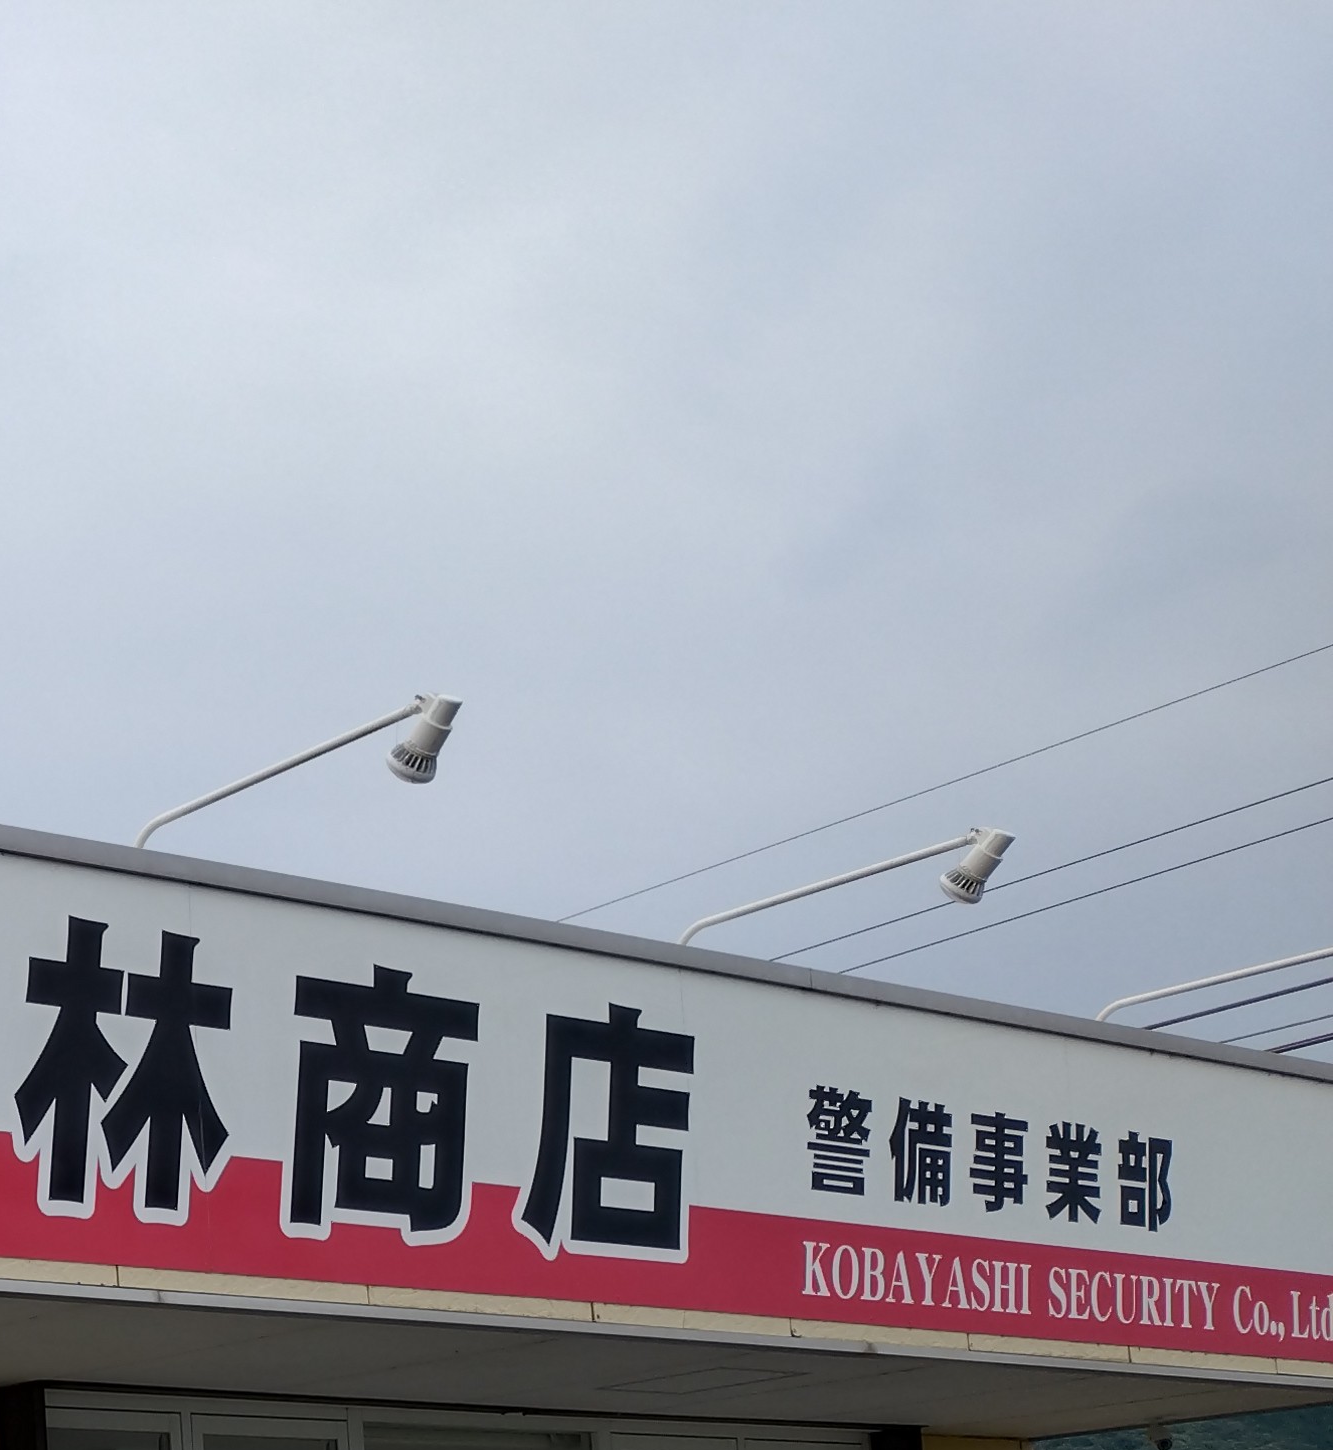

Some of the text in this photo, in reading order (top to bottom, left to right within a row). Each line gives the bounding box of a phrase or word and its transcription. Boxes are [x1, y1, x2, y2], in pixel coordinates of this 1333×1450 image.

[806, 1084, 1173, 1233] 警備事業部
[801, 1240, 1031, 1315] KOBAYASHI
[1048, 1266, 1221, 1331] SECURITY
